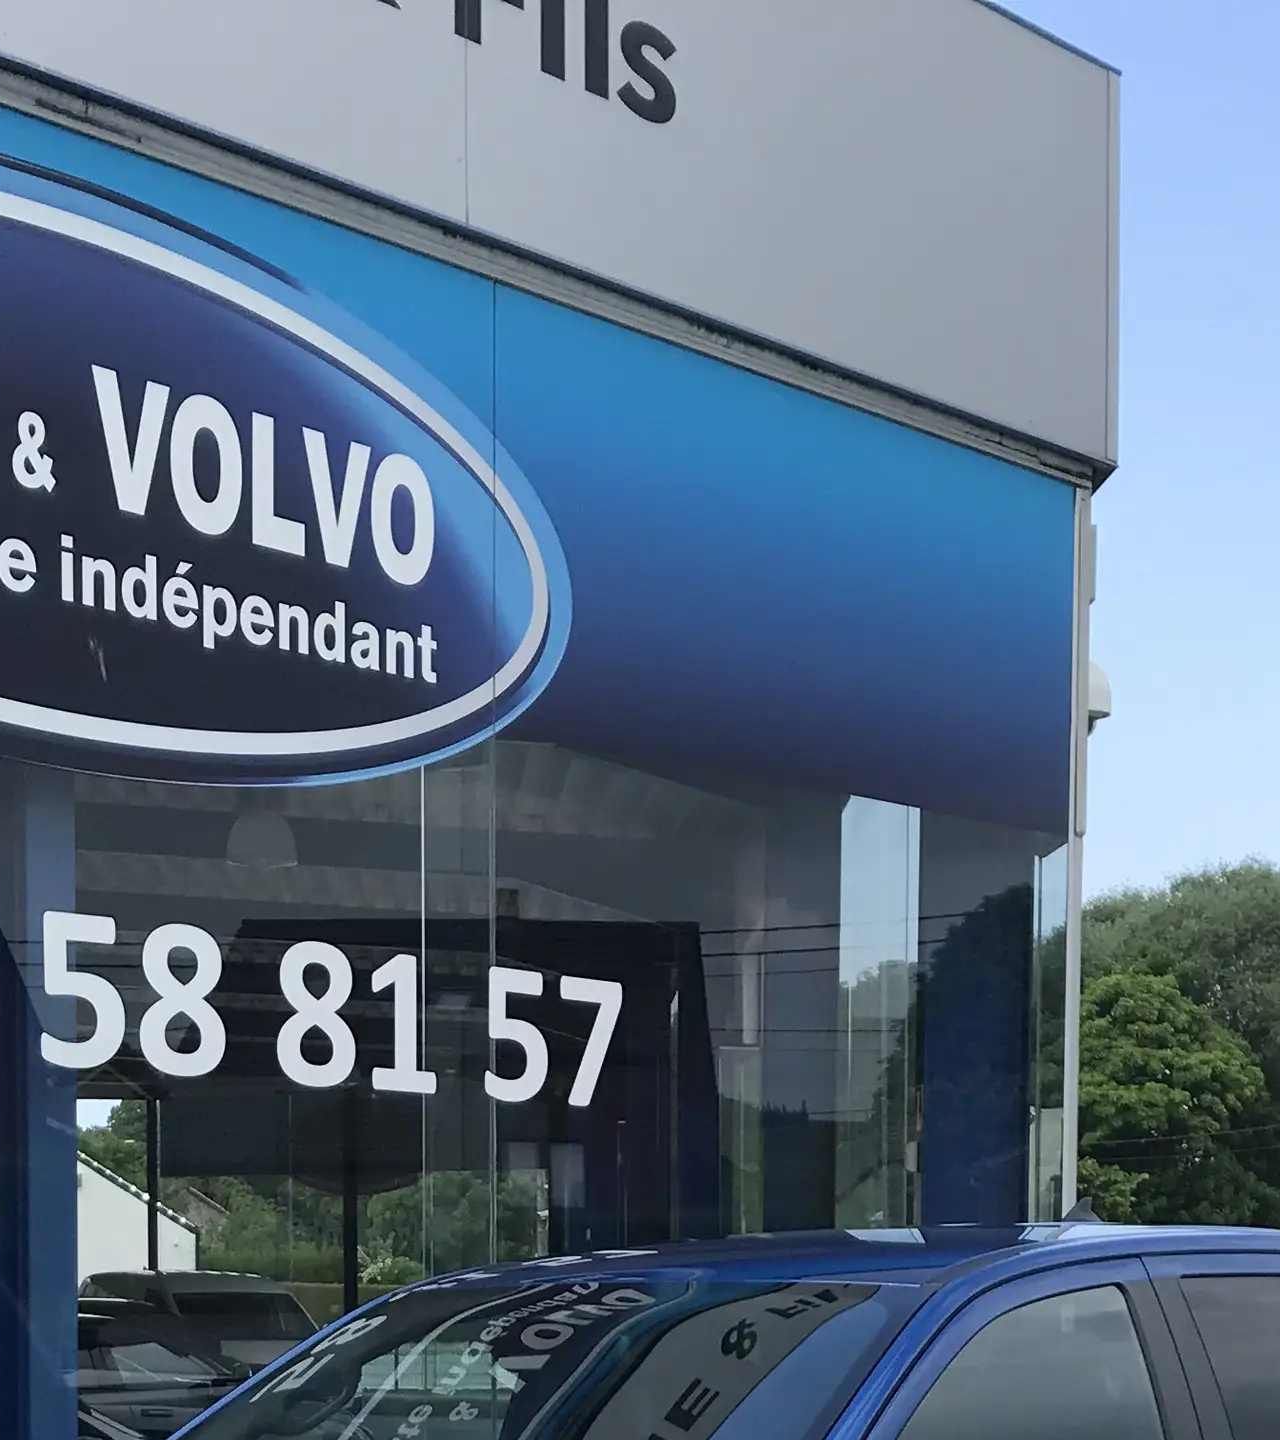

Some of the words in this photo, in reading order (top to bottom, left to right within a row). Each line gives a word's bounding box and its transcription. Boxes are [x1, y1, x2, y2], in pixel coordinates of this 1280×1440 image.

[11, 411, 56, 493] &
[91, 364, 435, 585] VOLVO
[60, 534, 438, 684] indépendant
[41, 910, 226, 1078] 58
[277, 940, 438, 1095] 81
[484, 965, 623, 1107] 57
